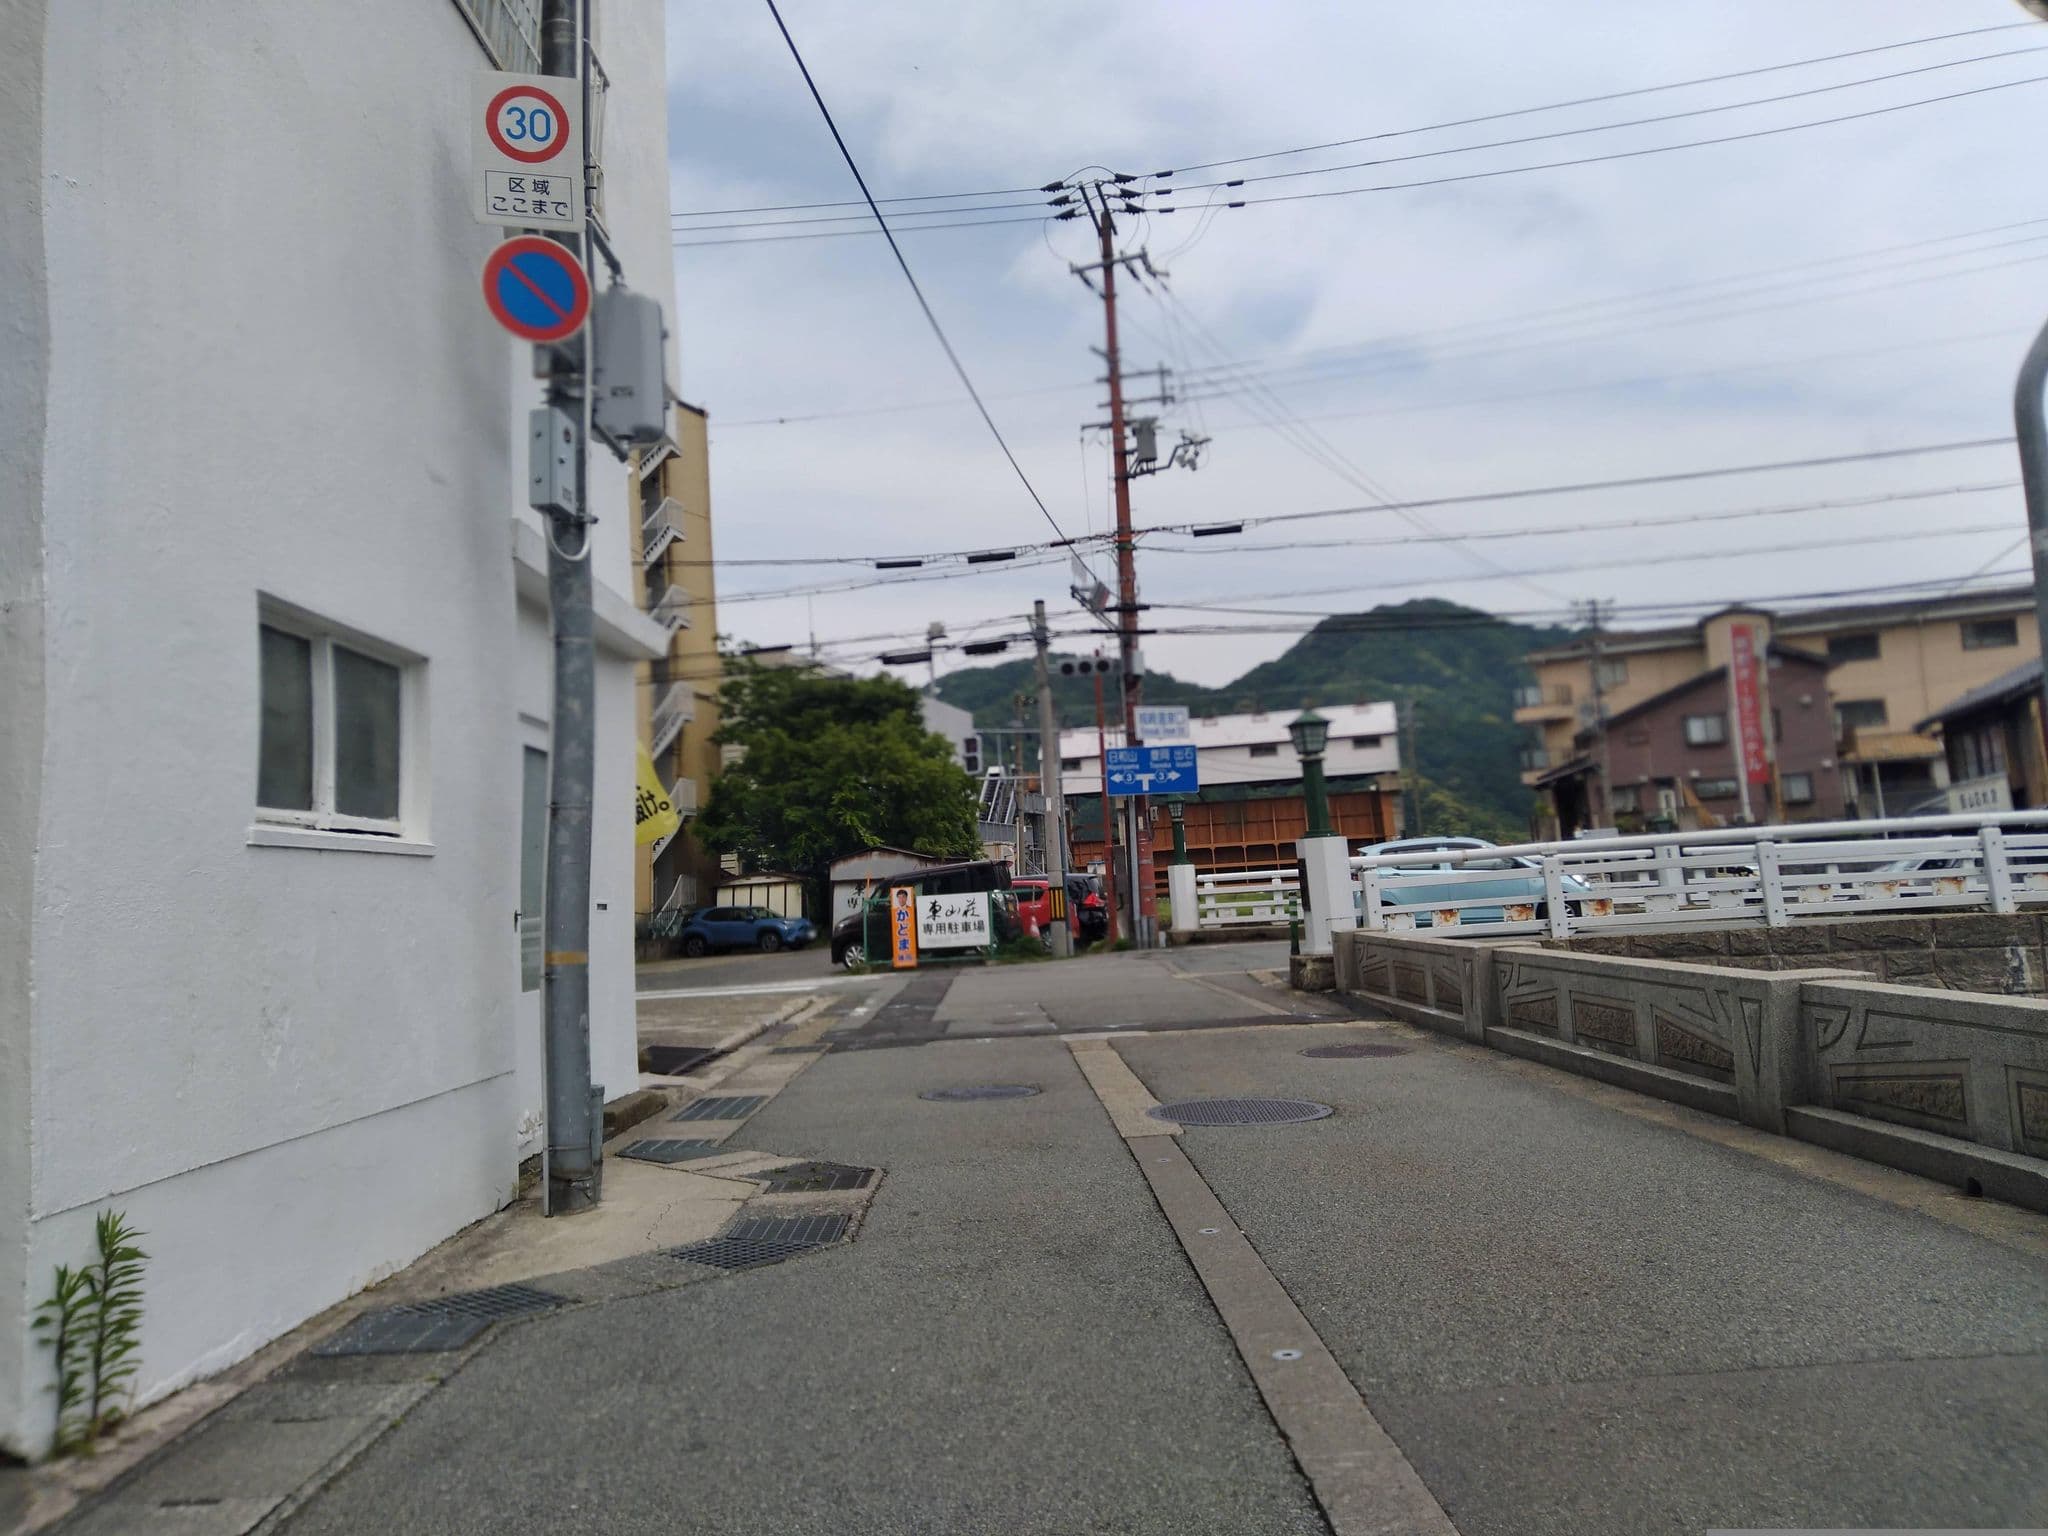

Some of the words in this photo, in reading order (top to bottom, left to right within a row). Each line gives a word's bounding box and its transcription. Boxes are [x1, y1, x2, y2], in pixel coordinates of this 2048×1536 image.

[505, 106, 551, 142] 30
[508, 177, 551, 196] 区域
[492, 196, 569, 217] ここまで
[923, 919, 985, 937] 専用駐車場
